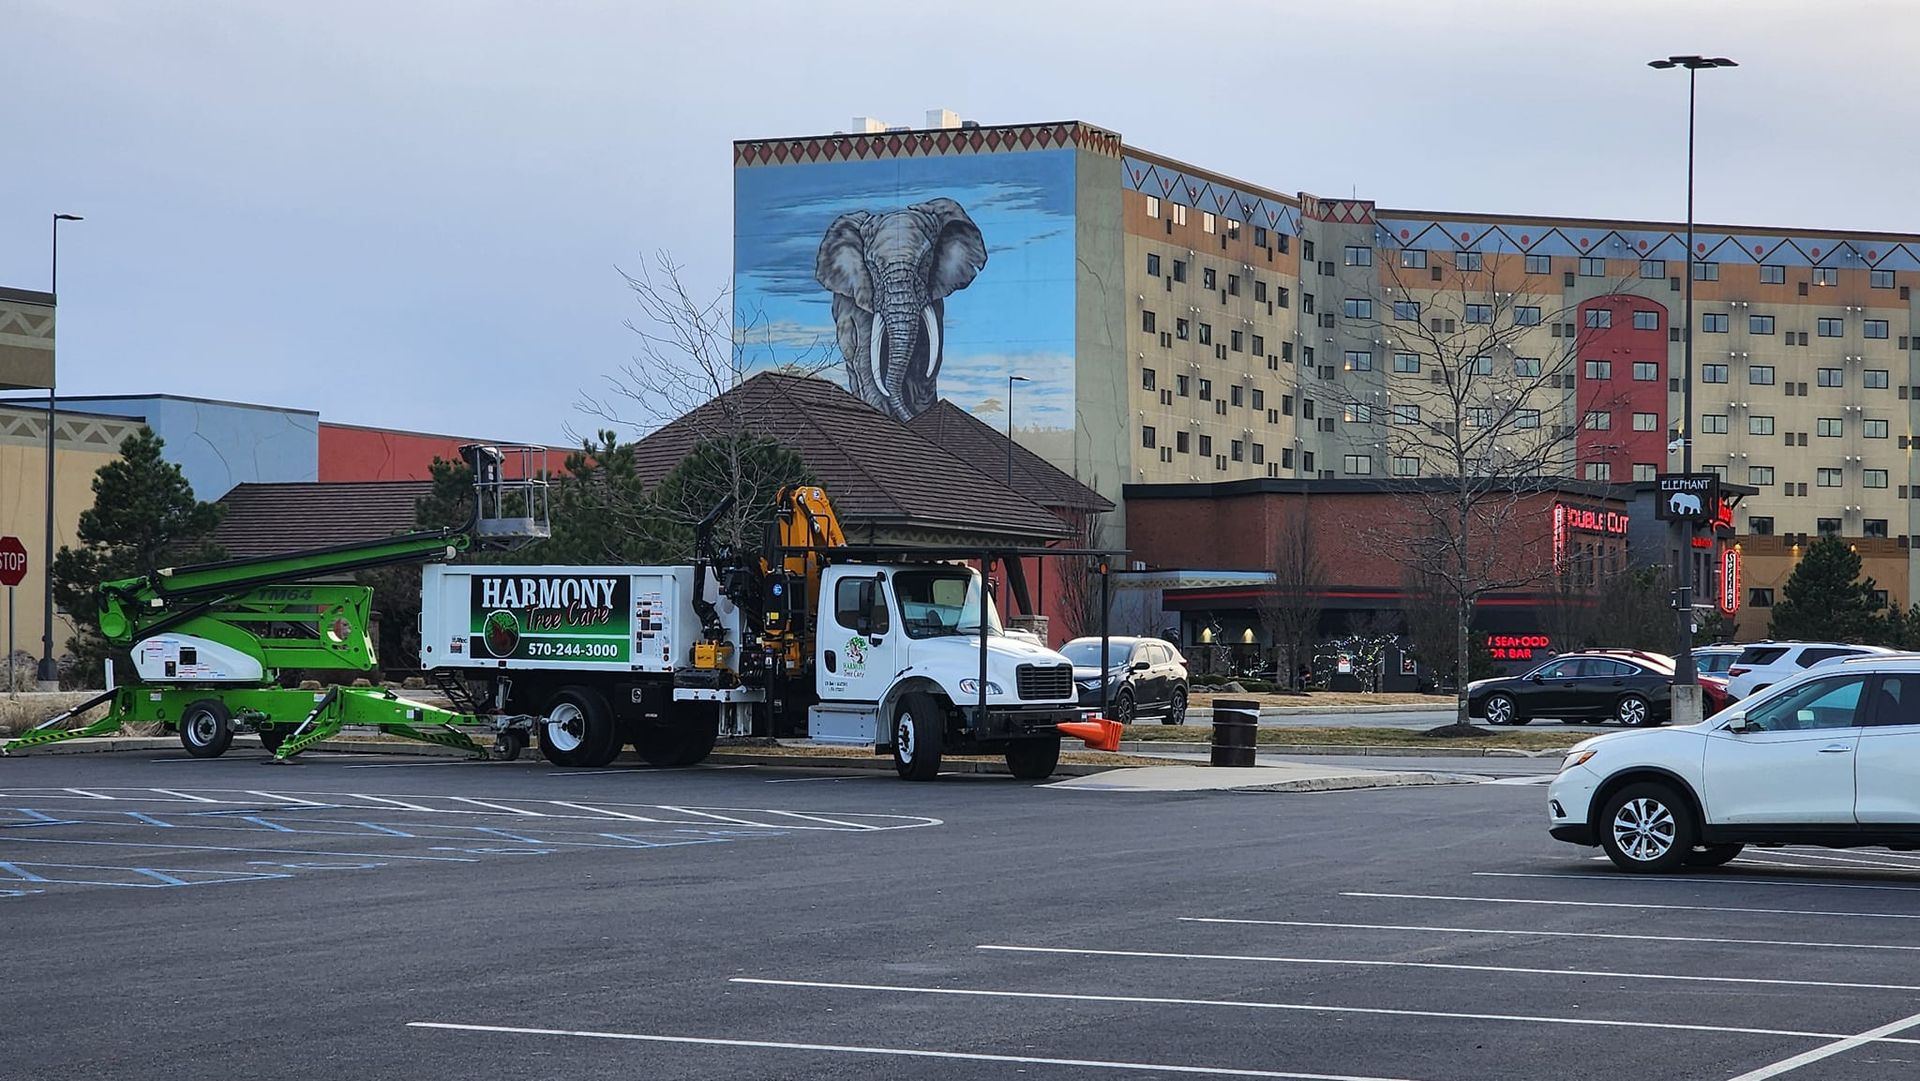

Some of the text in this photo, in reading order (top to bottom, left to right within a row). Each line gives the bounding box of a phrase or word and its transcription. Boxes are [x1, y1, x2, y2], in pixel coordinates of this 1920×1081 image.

[1661, 479, 1710, 490] ELEPHANT
[1607, 511, 1630, 534] CUT
[259, 588, 313, 601] TM64
[481, 578, 617, 609] HARMONY
[525, 605, 562, 631] Tree
[566, 600, 611, 627] Care
[528, 643, 618, 657] 570-244-3000
[1509, 648, 1531, 658] BAR
